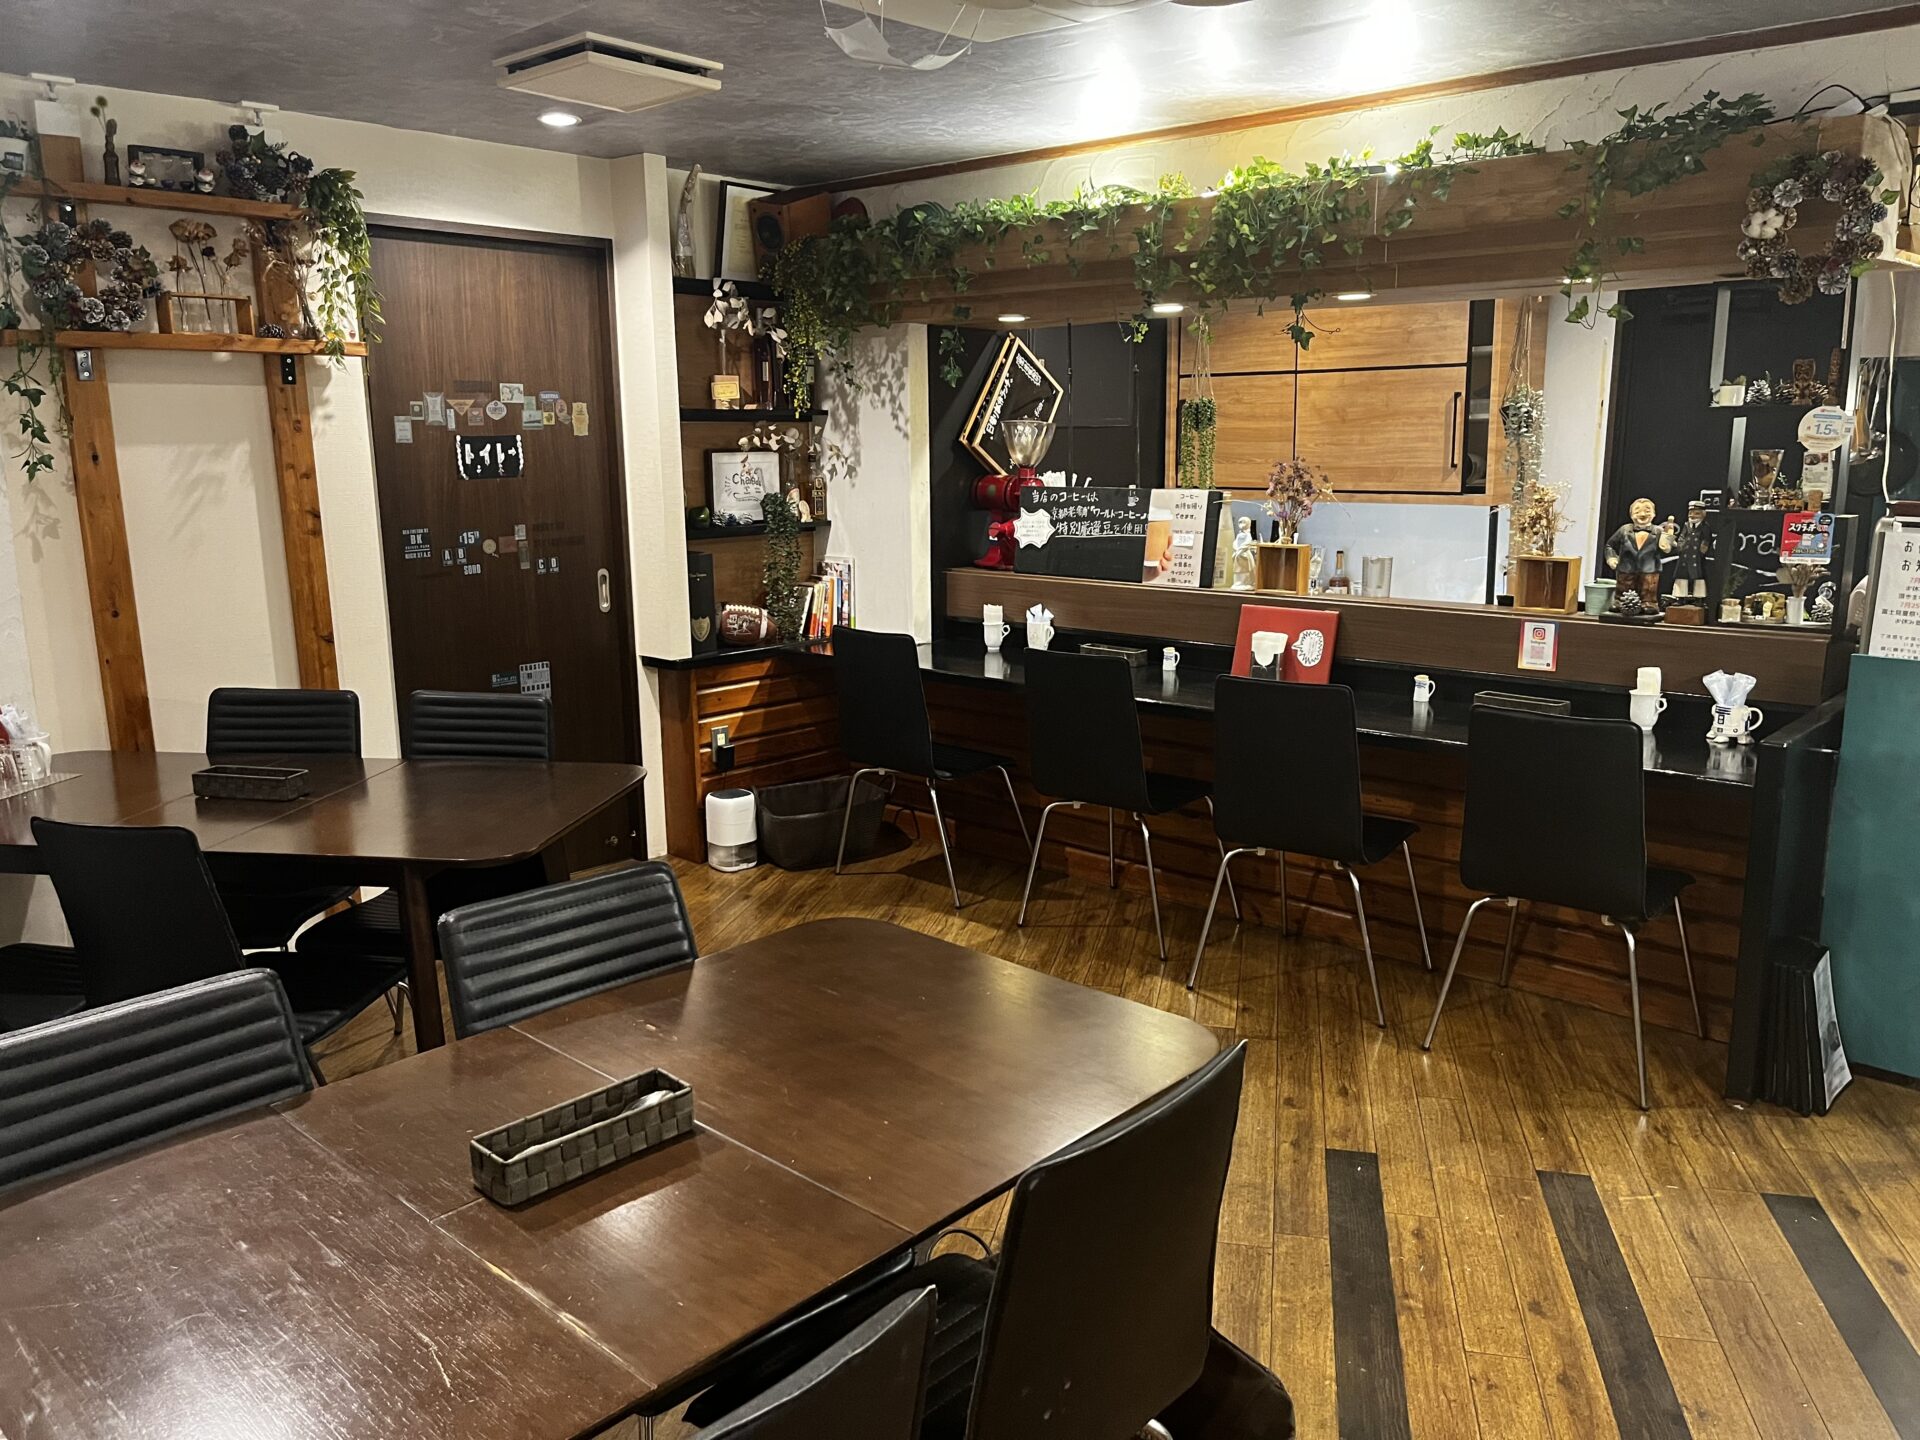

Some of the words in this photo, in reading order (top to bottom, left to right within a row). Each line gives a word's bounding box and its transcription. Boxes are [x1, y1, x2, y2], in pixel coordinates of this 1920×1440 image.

[1032, 489, 1099, 503] 当店のコーヒーは
